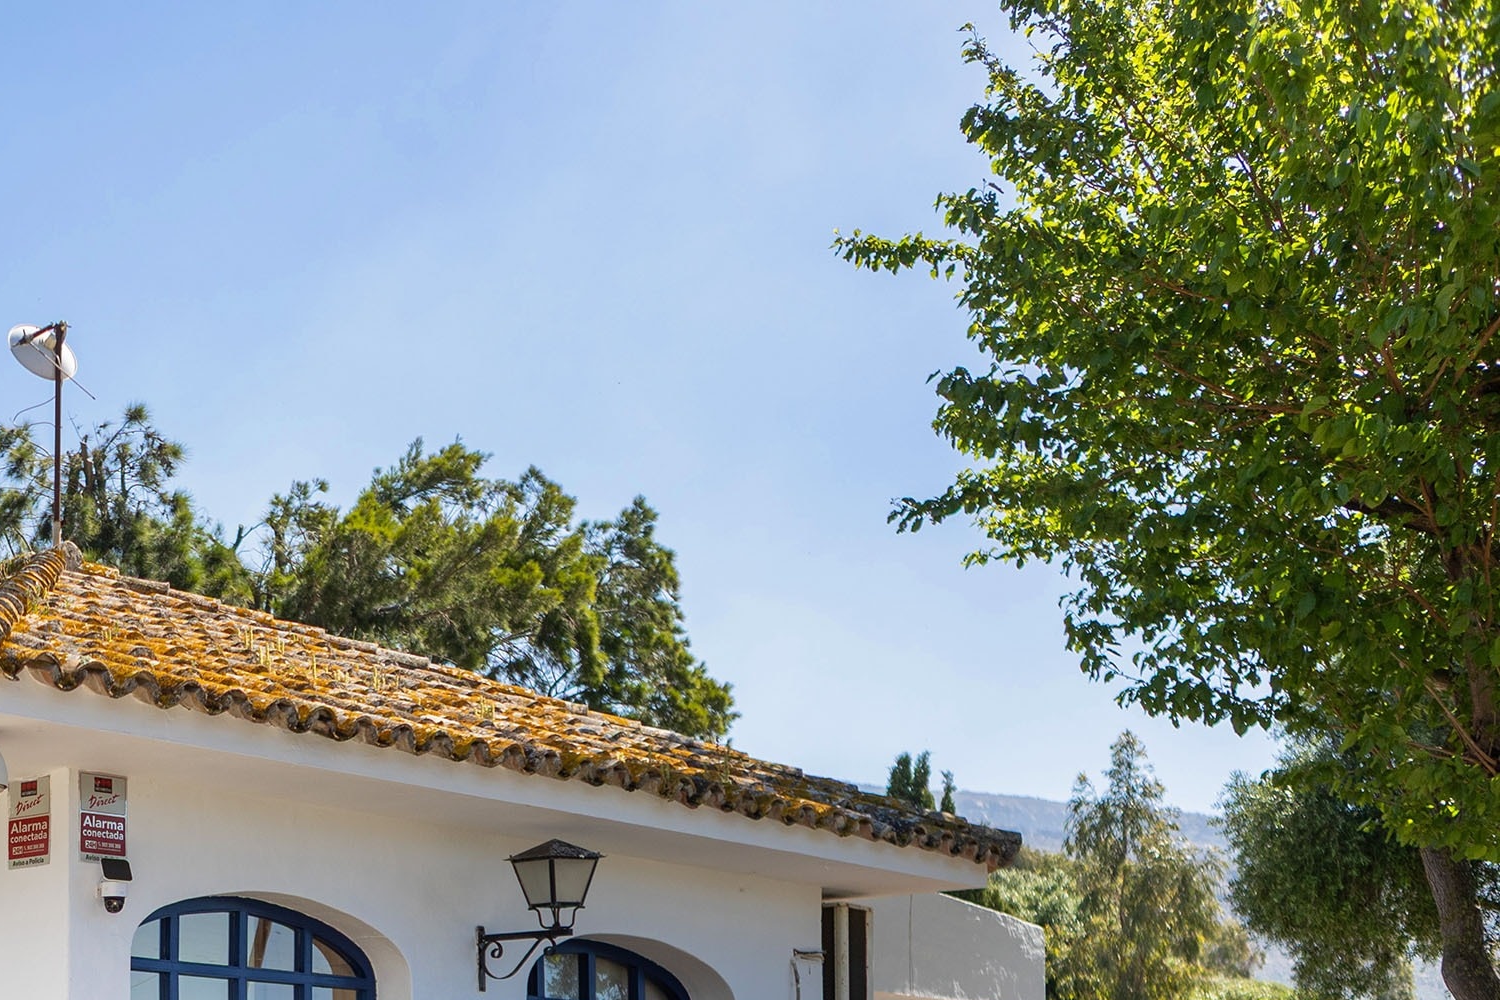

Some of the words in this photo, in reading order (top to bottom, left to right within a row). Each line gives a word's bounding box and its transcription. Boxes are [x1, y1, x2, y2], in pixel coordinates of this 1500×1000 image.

[88, 794, 120, 809] Direct
[11, 821, 48, 834] Alarma
[83, 816, 124, 831] Alarma
[10, 831, 48, 844] conectada
[83, 829, 124, 840] conectada
